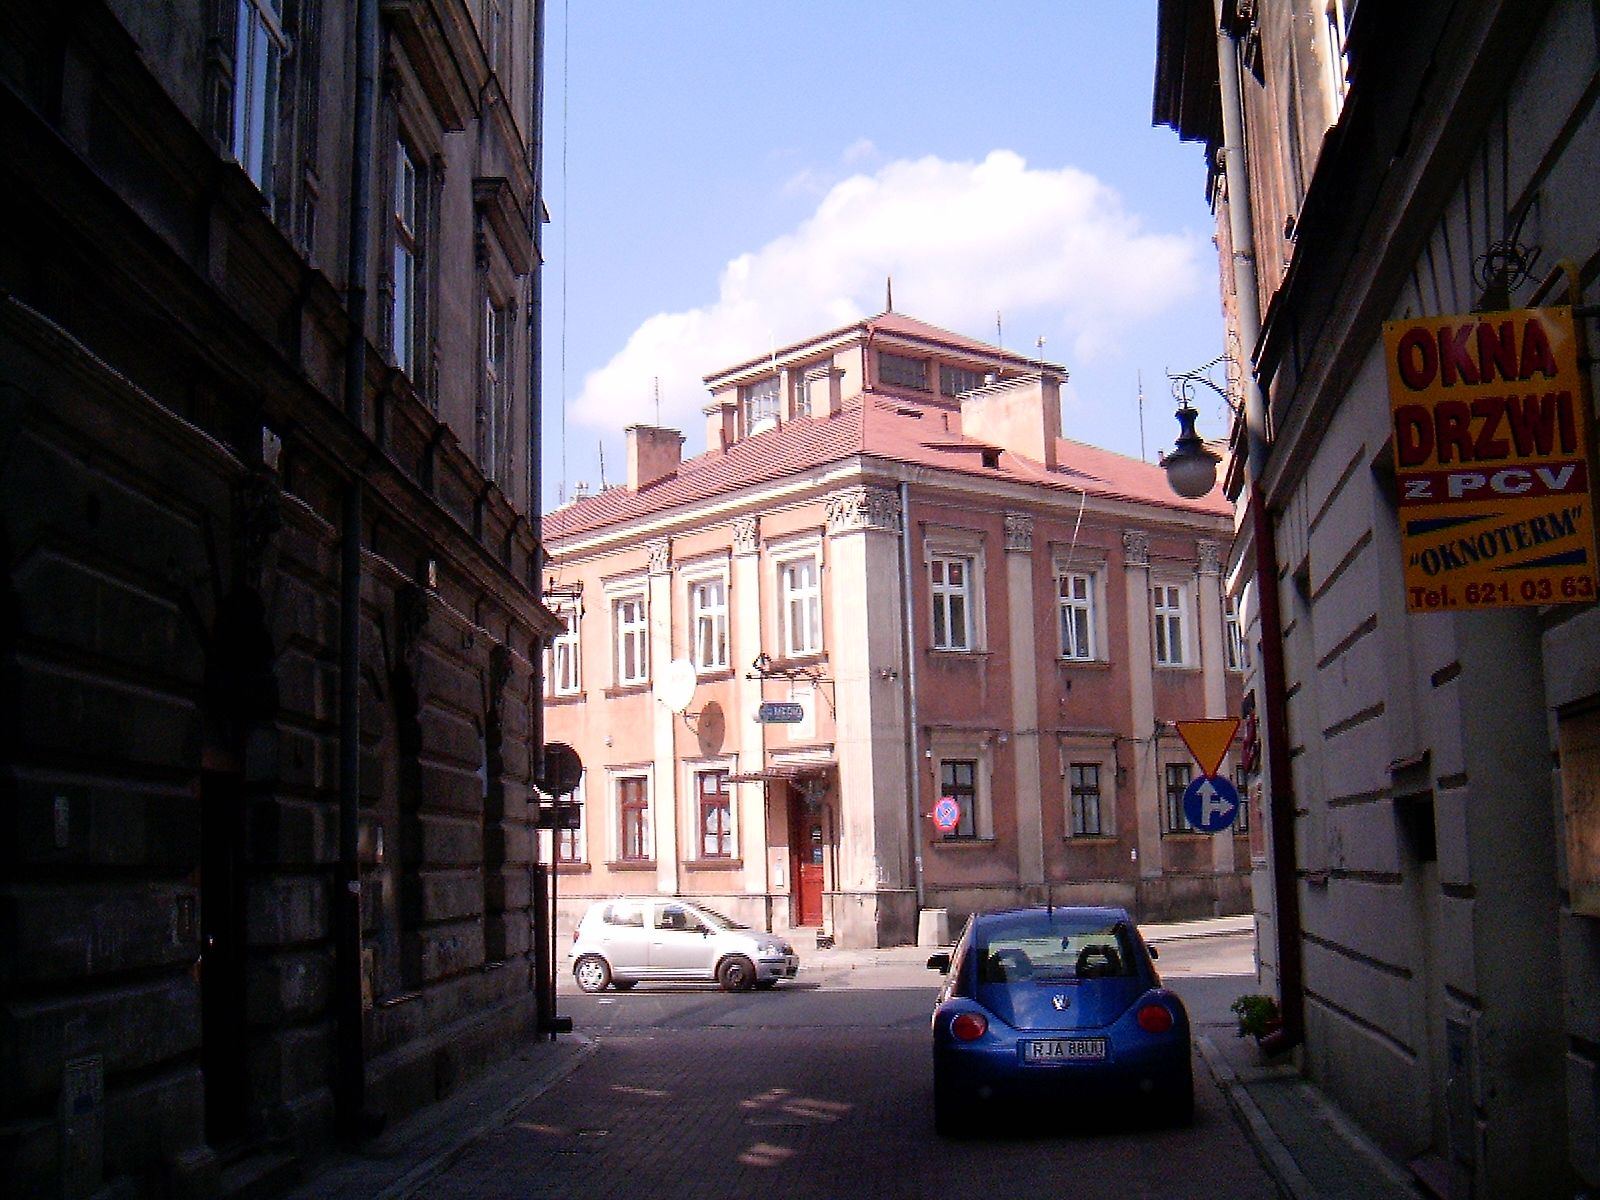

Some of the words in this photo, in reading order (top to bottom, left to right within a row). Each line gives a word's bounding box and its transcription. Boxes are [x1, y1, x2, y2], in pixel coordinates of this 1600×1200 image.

[1397, 319, 1558, 391] OKNA
[1395, 391, 1577, 467] DRZWI
[1448, 465, 1576, 498] PCV
[1409, 585, 1457, 608] Tel.
[1465, 581, 1509, 603] 621
[1520, 578, 1552, 600] 03
[1561, 575, 1593, 598] 63
